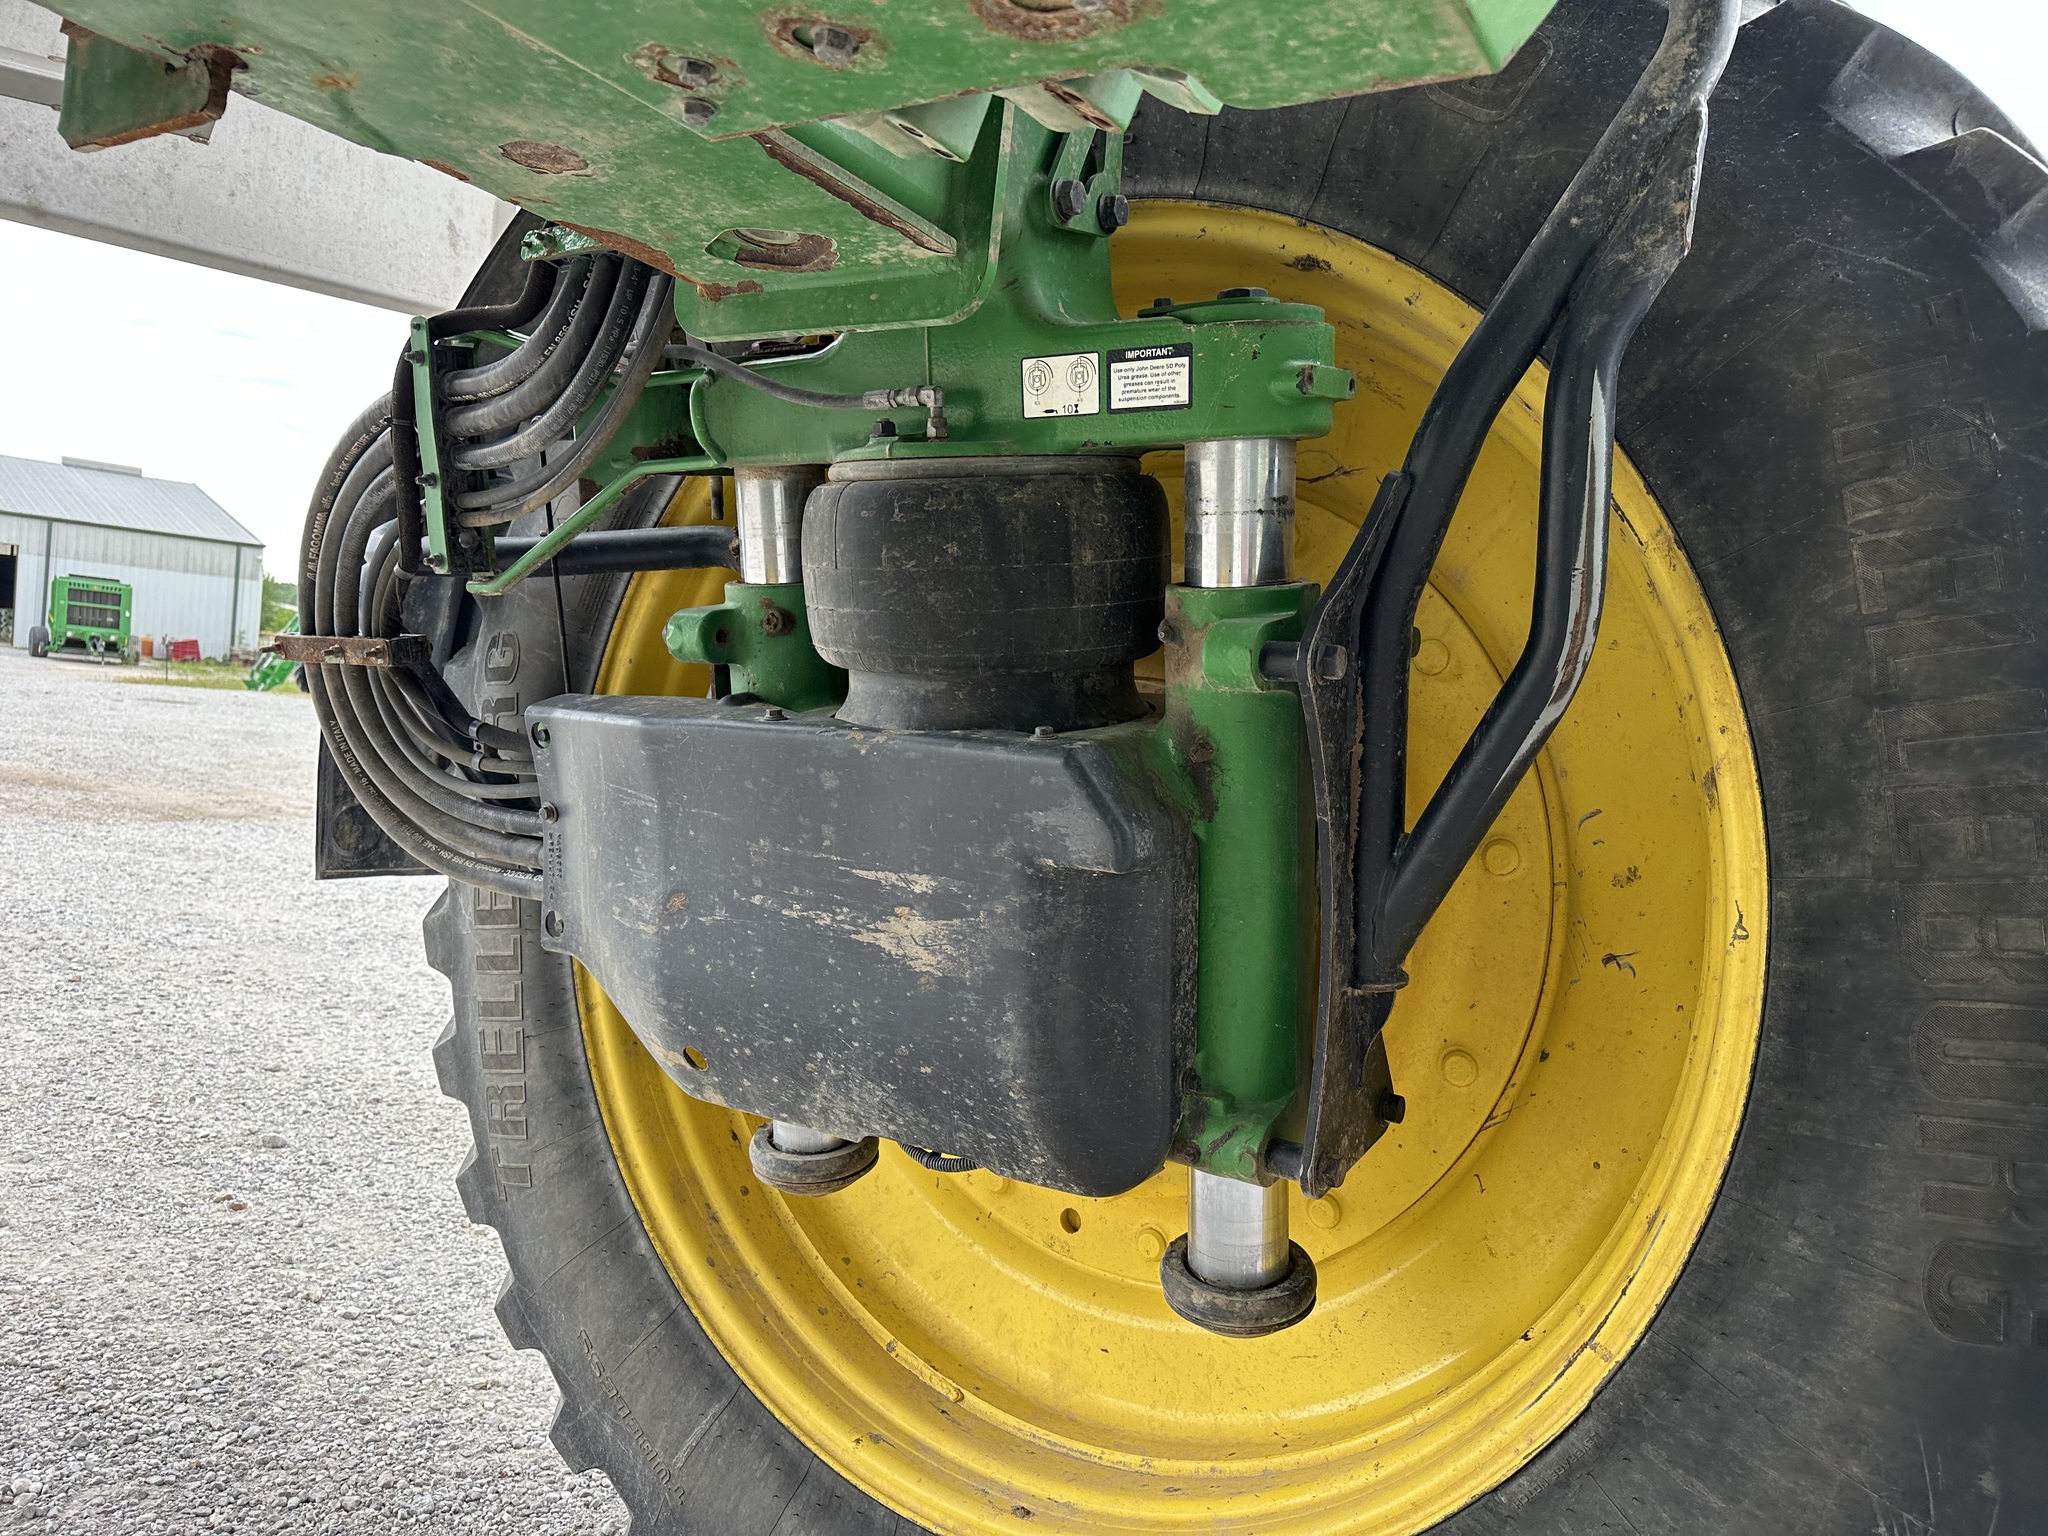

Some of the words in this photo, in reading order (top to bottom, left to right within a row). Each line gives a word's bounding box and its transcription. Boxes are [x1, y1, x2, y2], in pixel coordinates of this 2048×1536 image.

[1125, 347, 1174, 359] IMPORTANT
[1062, 404, 1073, 414] 10
[309, 512, 327, 572] ALFAGOMMA
[330, 720, 344, 742] ITALY
[339, 740, 348, 752] IN
[345, 750, 361, 774] MADE
[1816, 288, 2048, 1346] TRELLEBORG
[422, 838, 438, 853] SAE
[577, 1328, 686, 1505] TUBELESS
[1550, 1431, 1602, 1480] LEVERAGE
[1512, 1477, 1550, 1509] NOTCH
